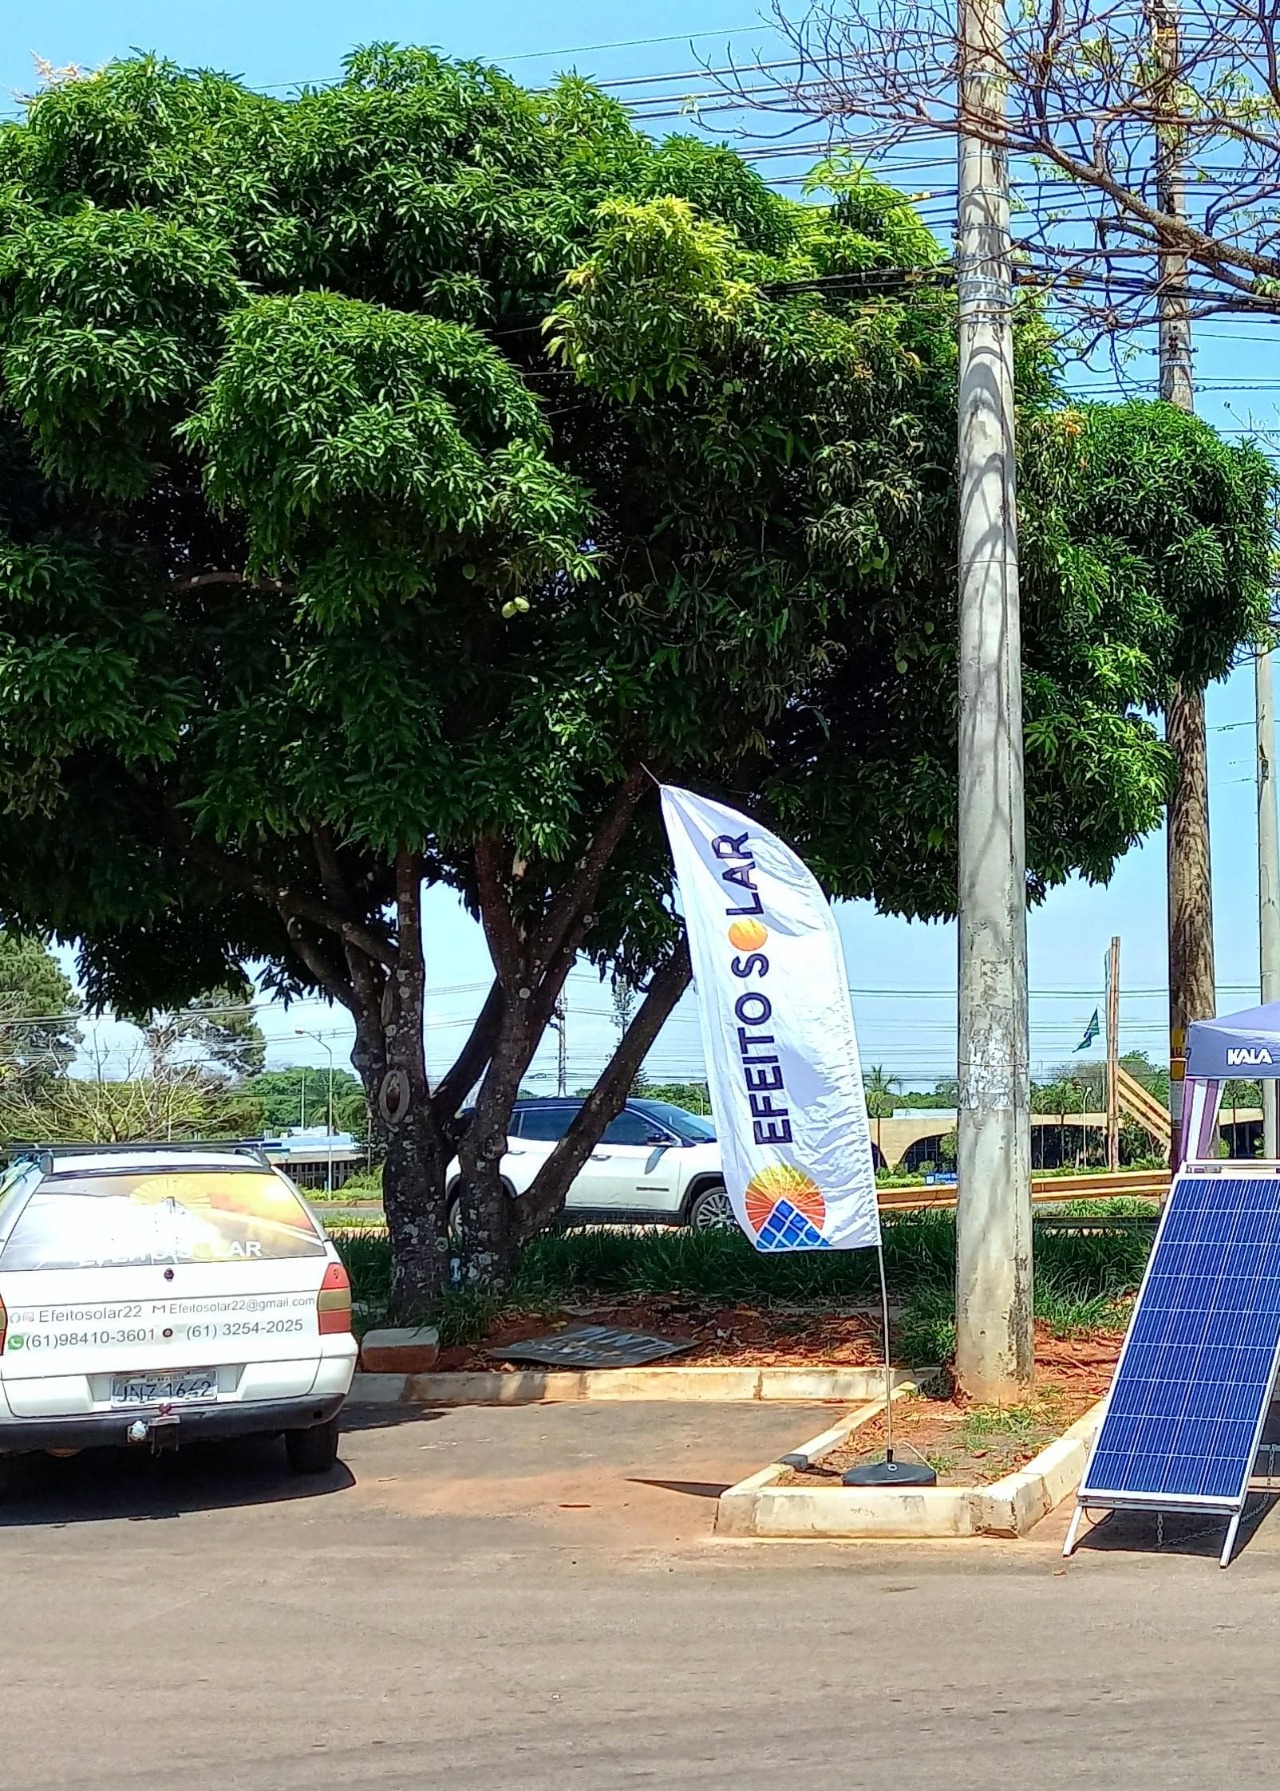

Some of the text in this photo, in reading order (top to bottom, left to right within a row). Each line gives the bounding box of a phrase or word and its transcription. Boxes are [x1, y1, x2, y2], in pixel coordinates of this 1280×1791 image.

[735, 992, 793, 1145] EFEITO
[1226, 1048, 1274, 1065] KALA
[39, 1305, 142, 1323] Efeitosolar22
[169, 1297, 315, 1315] Efeitosolar22@gmail.com
[26, 1319, 303, 1350] (61)98410-3601 (61) 3254-2025
